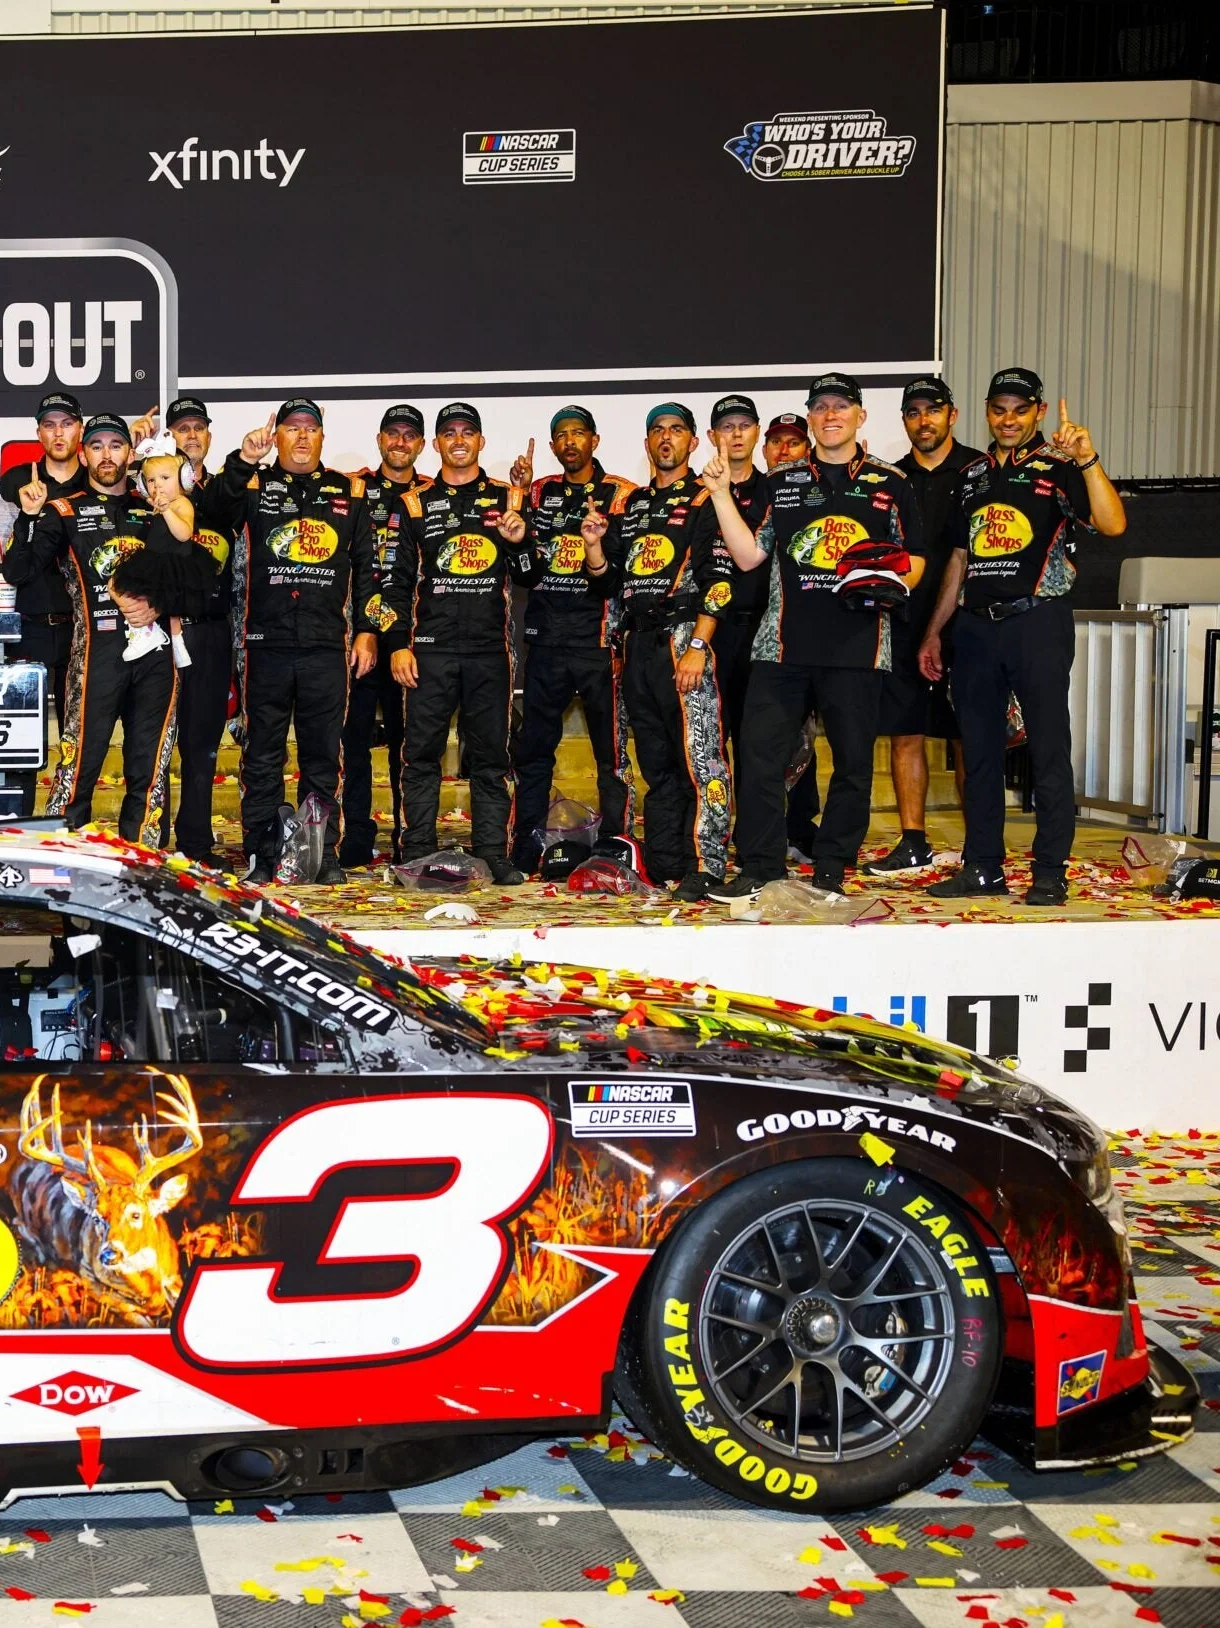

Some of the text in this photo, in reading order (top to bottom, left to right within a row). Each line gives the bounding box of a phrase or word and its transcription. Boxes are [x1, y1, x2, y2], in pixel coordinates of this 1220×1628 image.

[764, 121, 882, 142] WHO'S YOUR
[497, 133, 558, 151] NASCAR
[784, 140, 912, 169] DRIVER?
[148, 137, 306, 189] xfinity
[478, 155, 560, 174] CUP SERIES
[2, 300, 143, 386] OUT
[986, 506, 1015, 522] Bass
[299, 520, 326, 534] Bass
[823, 518, 856, 535] Bass
[985, 520, 1007, 534] Pro
[299, 533, 320, 546] Pro
[458, 535, 484, 548] Bass
[559, 535, 583, 548] Bass
[643, 536, 662, 547] Bass
[823, 533, 849, 546] Pro
[983, 534, 1022, 552] Shops
[298, 543, 331, 560] Shops
[458, 547, 477, 558] Pro
[558, 546, 576, 558] Pro
[642, 547, 657, 559] Pro
[458, 556, 489, 571] Shops
[641, 557, 665, 571] Shops
[267, 566, 336, 577] WINCHESTER
[283, 576, 332, 587] The American Legend
[432, 577, 497, 585] WINCHESTER
[476, 586, 492, 594] Legend
[93, 609, 118, 617] sparco
[692, 689, 708, 785] WINCHESTER
[200, 921, 391, 1027] R3-IT.COM
[1148, 1001, 1220, 1053] VI
[609, 1086, 674, 1101] NASCAR
[589, 1110, 677, 1124] CUP SERIES
[180, 1091, 557, 1368] 3
[902, 1195, 989, 1298] EAGLE
